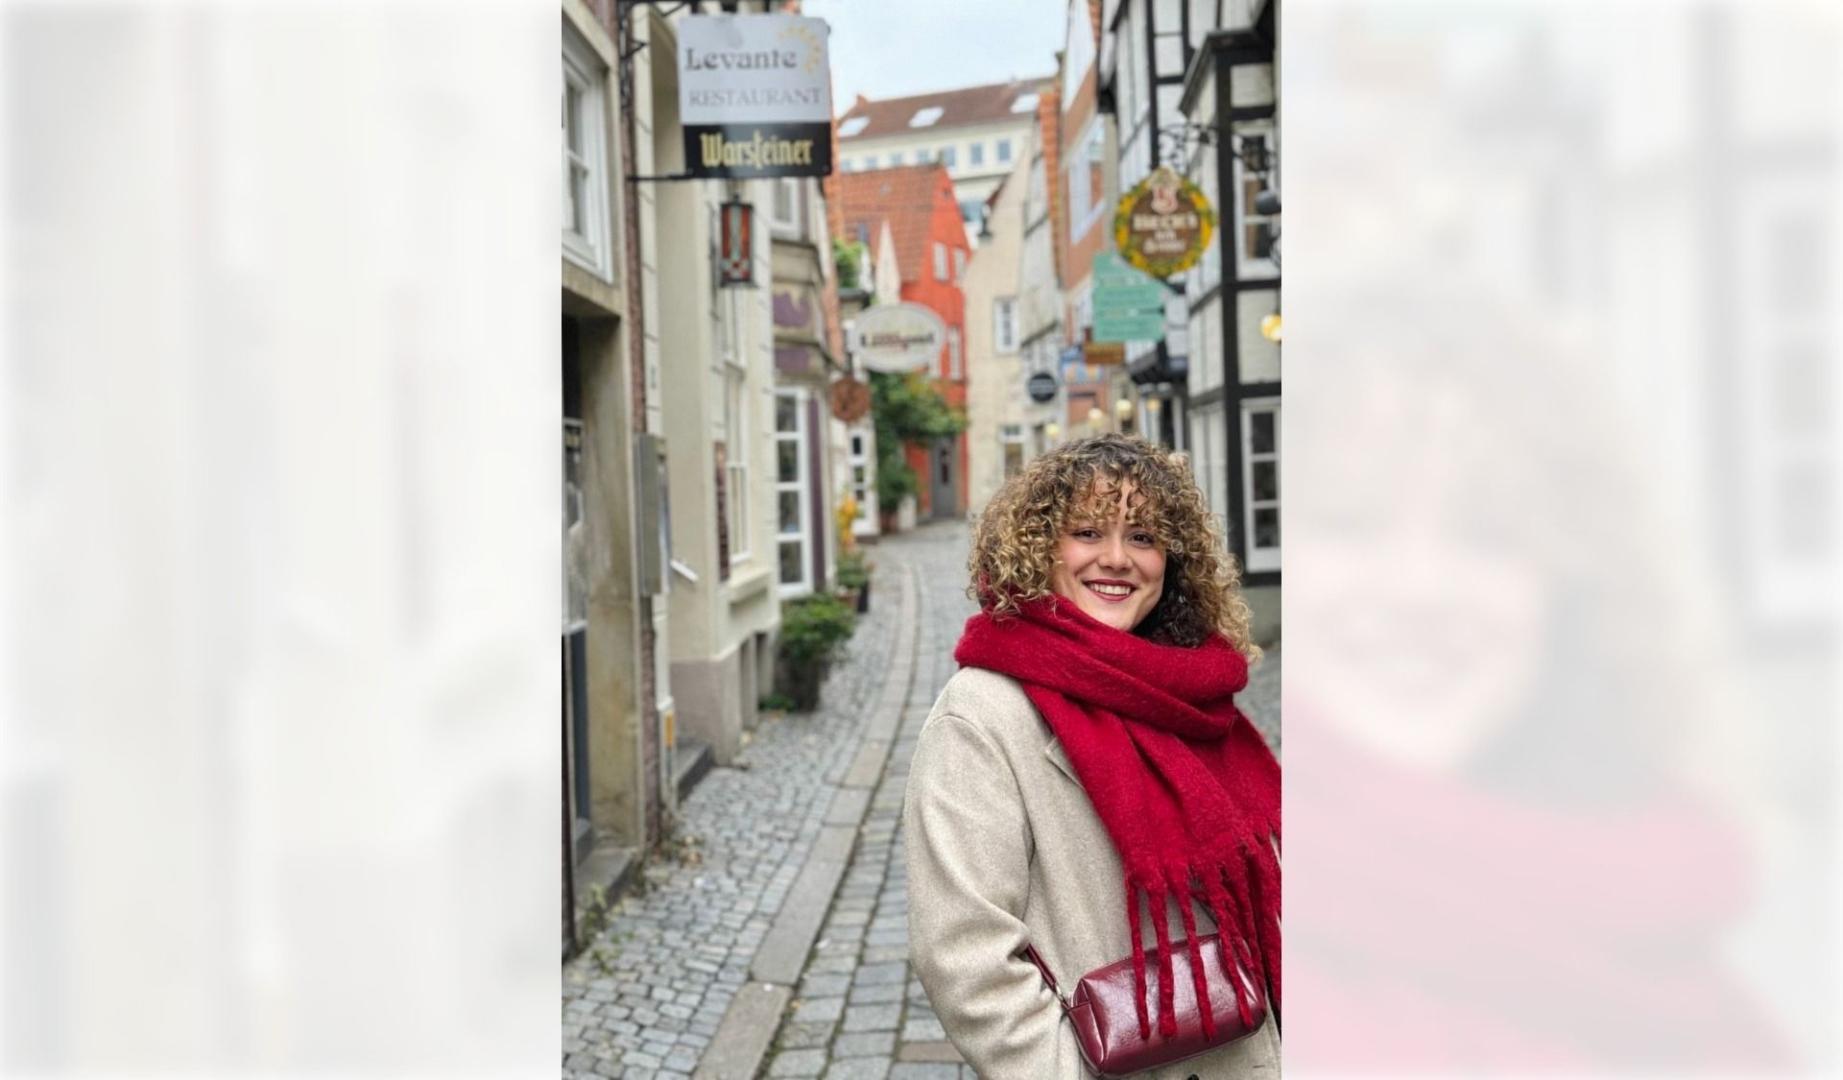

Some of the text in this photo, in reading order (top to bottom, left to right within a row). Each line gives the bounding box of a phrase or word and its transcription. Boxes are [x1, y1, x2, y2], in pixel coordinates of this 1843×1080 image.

[685, 48, 798, 70] Levante
[688, 87, 822, 107] RESTAURANT
[700, 129, 813, 169] Warsteiner
